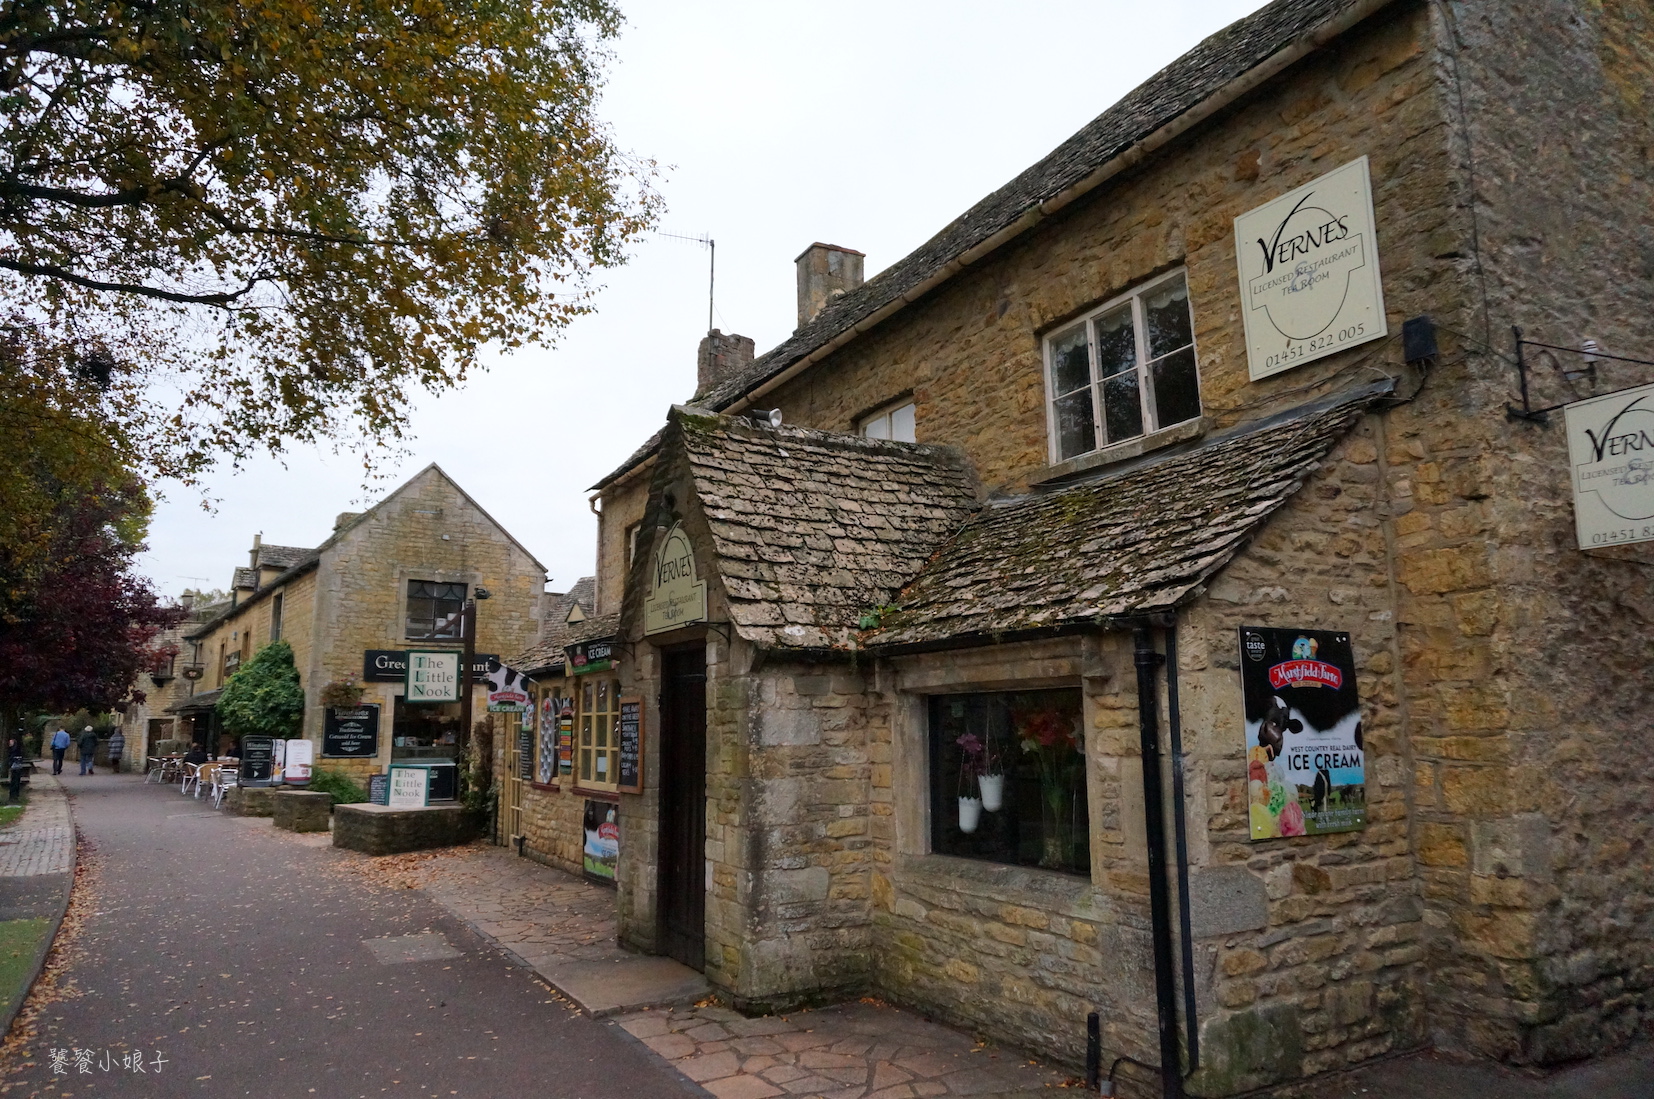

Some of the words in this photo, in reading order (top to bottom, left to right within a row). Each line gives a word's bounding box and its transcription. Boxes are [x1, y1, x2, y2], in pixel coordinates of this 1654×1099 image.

[1257, 191, 1348, 274] VERNES
[1253, 272, 1294, 295] LICENSED
[1295, 245, 1358, 276] RESTAURANT
[1300, 271, 1329, 290] ROOM
[1265, 344, 1304, 368] 01451
[1309, 334, 1334, 353] 822
[1338, 322, 1365, 343] 005
[1592, 528, 1635, 544] 01451
[655, 520, 692, 589] VERNES
[595, 646, 611, 658] CREAM
[1246, 642, 1265, 650] taste
[415, 657, 444, 669] The
[415, 670, 454, 683] Little
[413, 685, 451, 697] Nook
[1288, 754, 1310, 770] ICE
[1314, 753, 1361, 769] CREAM
[396, 770, 415, 778] The
[395, 780, 422, 788] Little
[394, 789, 420, 797] Nook
